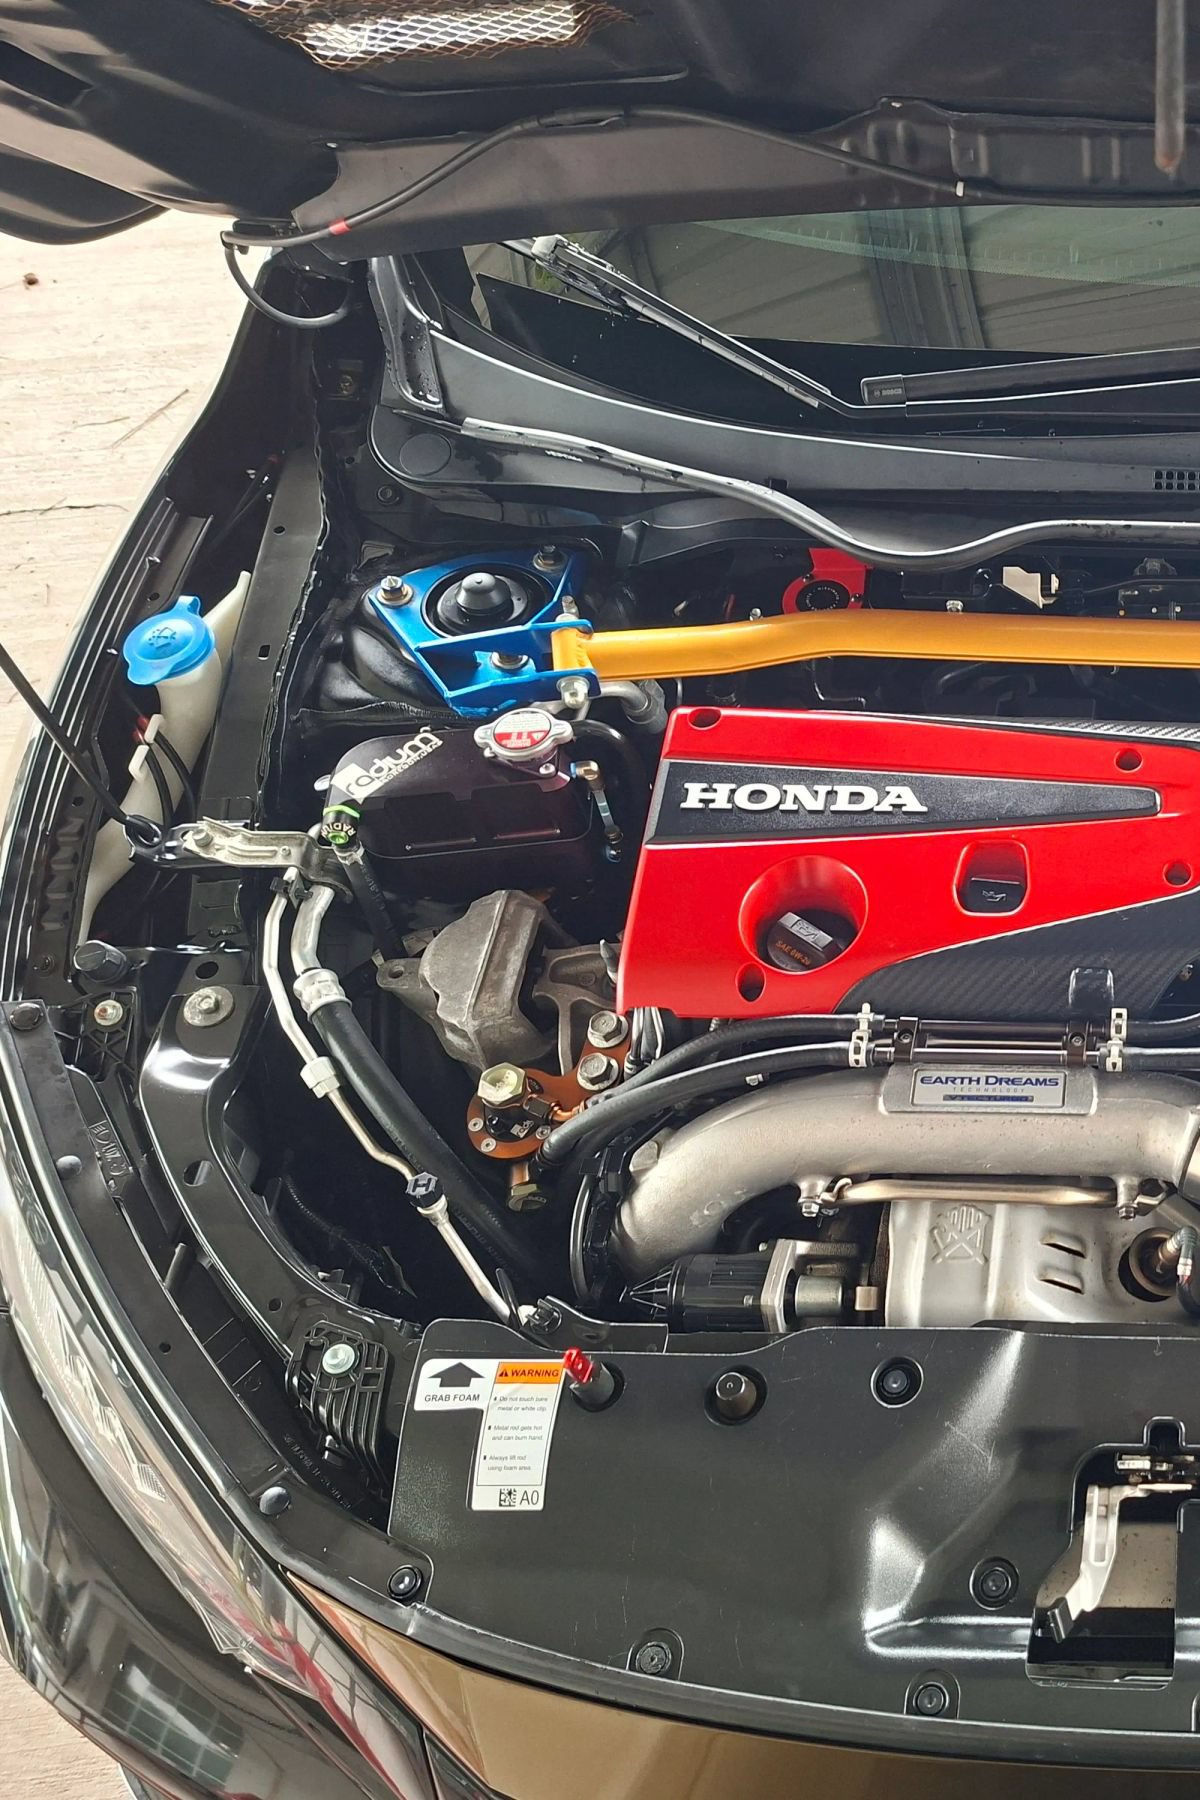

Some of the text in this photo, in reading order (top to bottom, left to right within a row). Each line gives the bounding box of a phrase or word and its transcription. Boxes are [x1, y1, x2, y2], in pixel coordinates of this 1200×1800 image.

[680, 782, 928, 812] HONDA
[920, 1075, 1059, 1086] EARTH DREAMS
[511, 1369, 559, 1377] WARNING
[424, 1394, 450, 1402] GRAB
[519, 1490, 539, 1505] A0
